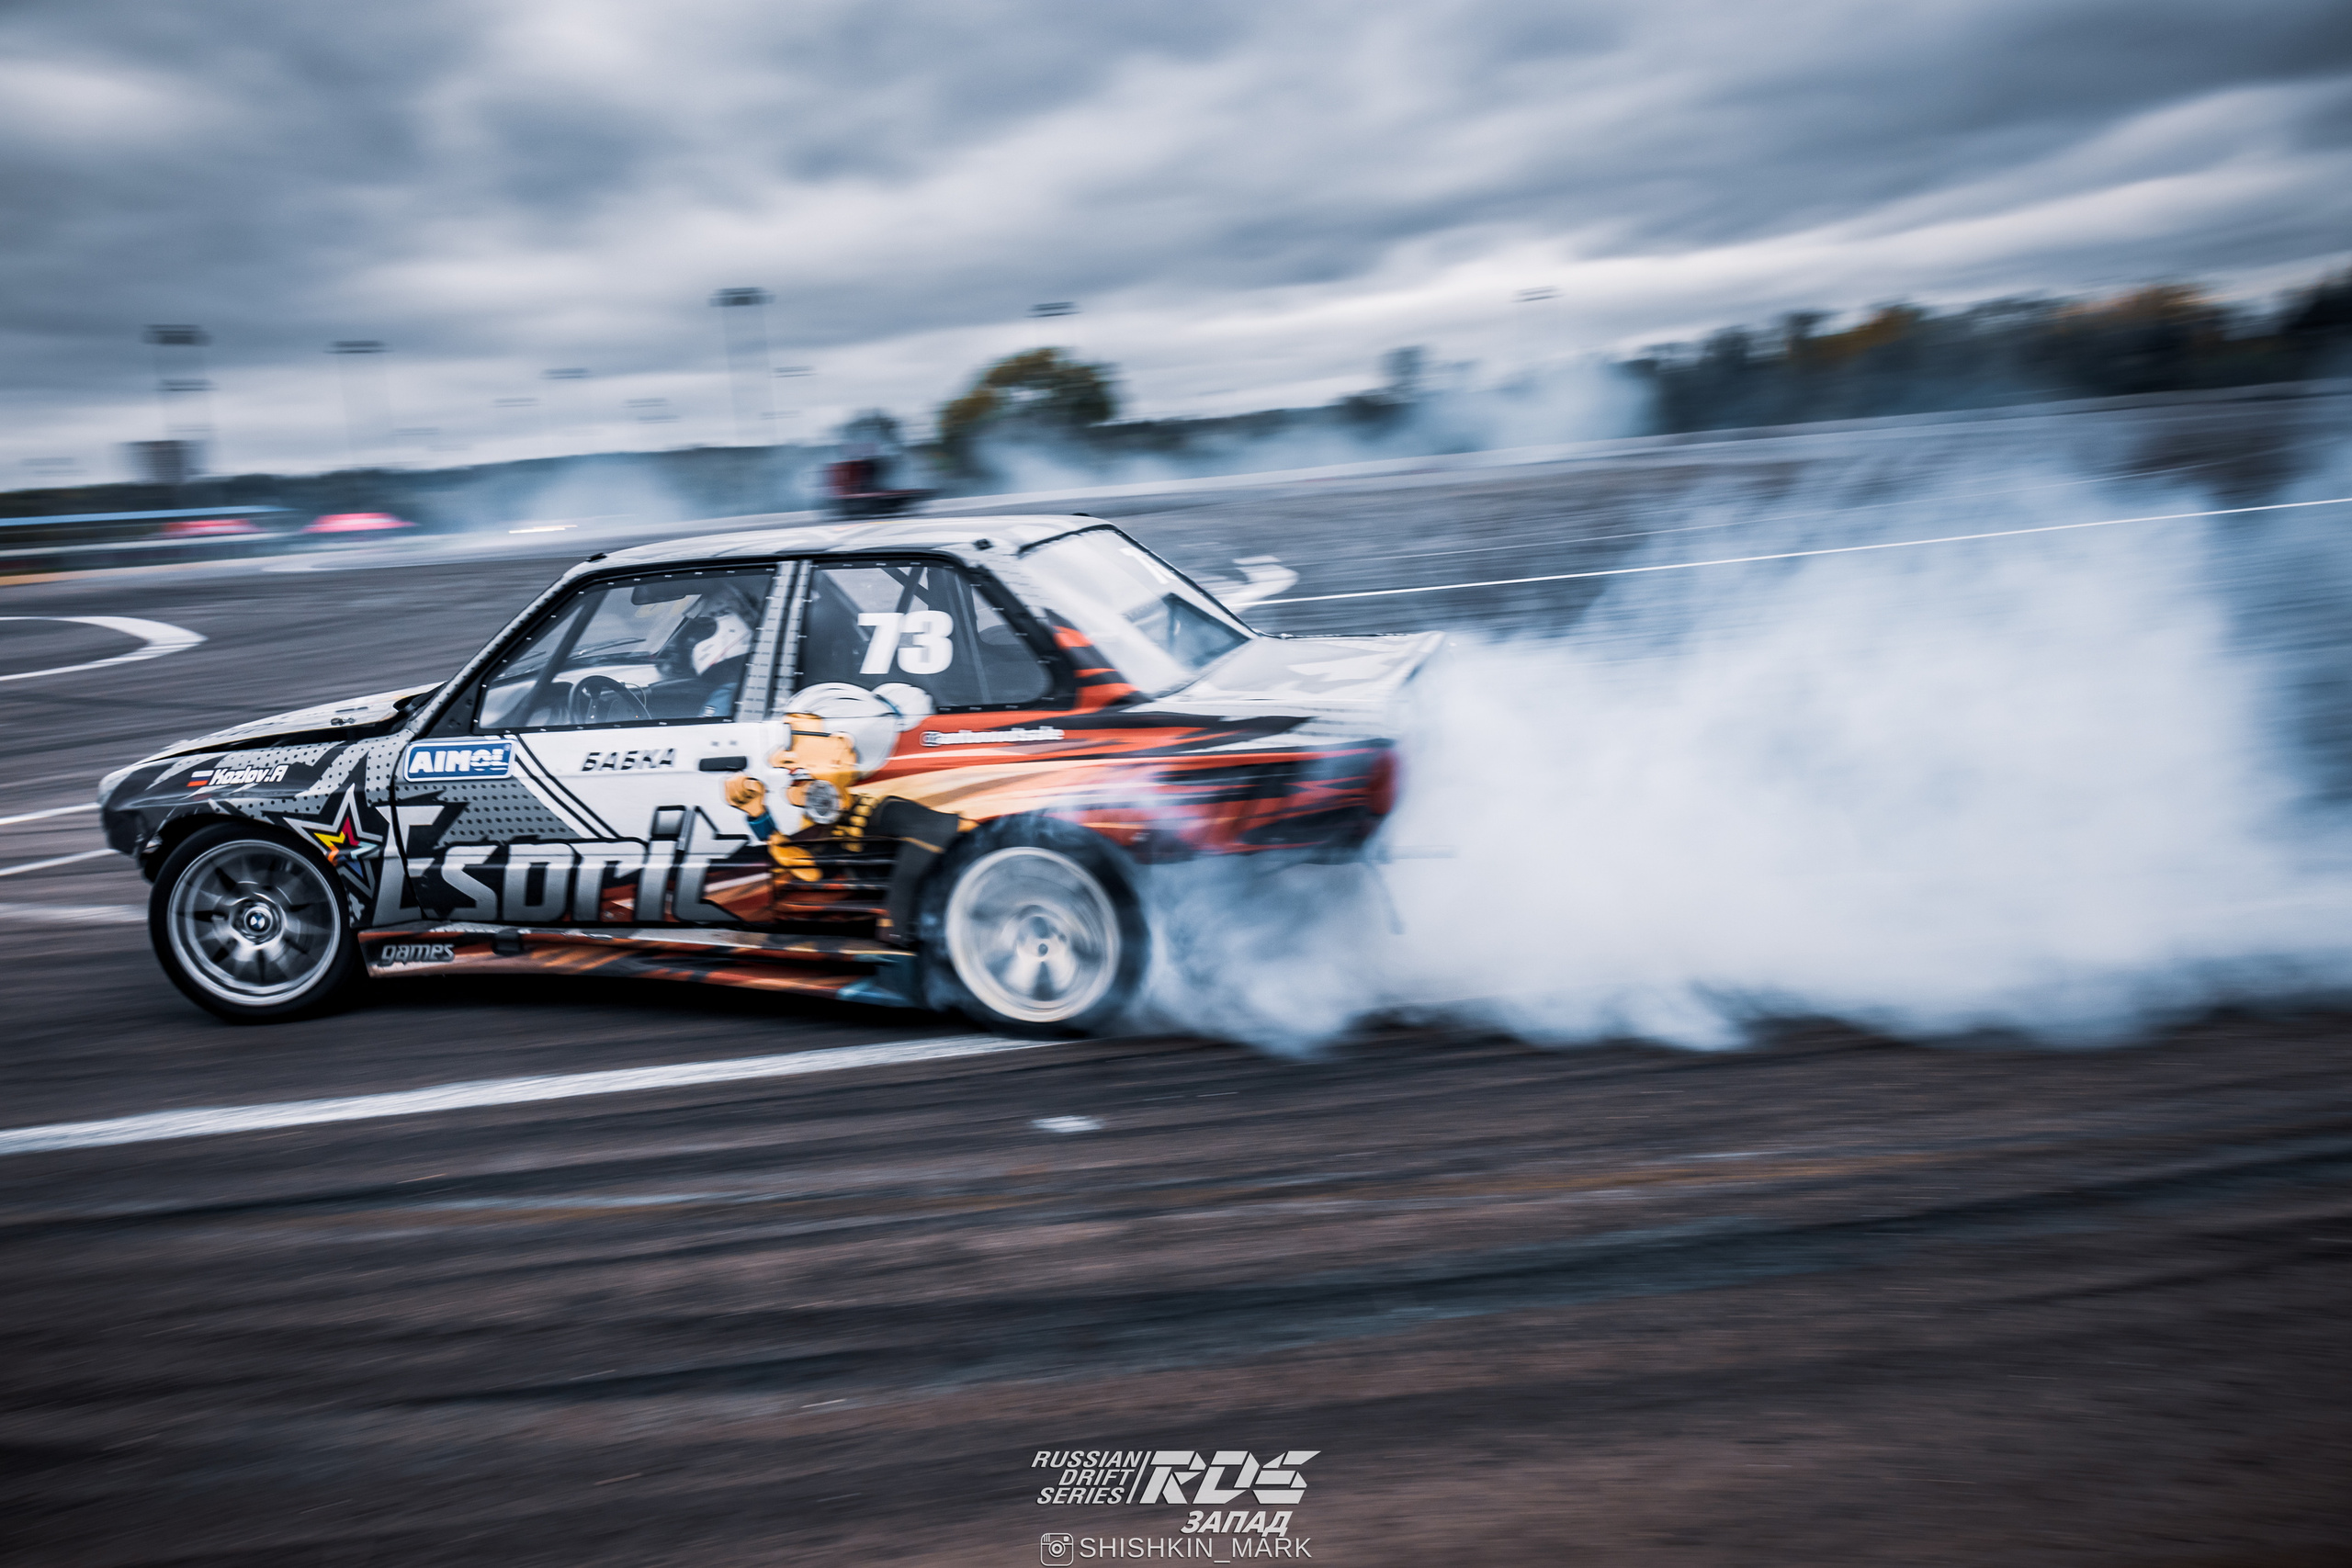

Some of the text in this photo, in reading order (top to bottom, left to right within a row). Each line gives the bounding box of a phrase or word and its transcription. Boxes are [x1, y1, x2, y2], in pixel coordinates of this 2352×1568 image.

[857, 610, 954, 675] 73
[408, 748, 509, 773] AIMOL
[581, 748, 676, 772] БАБКА
[208, 764, 289, 786] Kozlov.A
[380, 942, 455, 964] games
